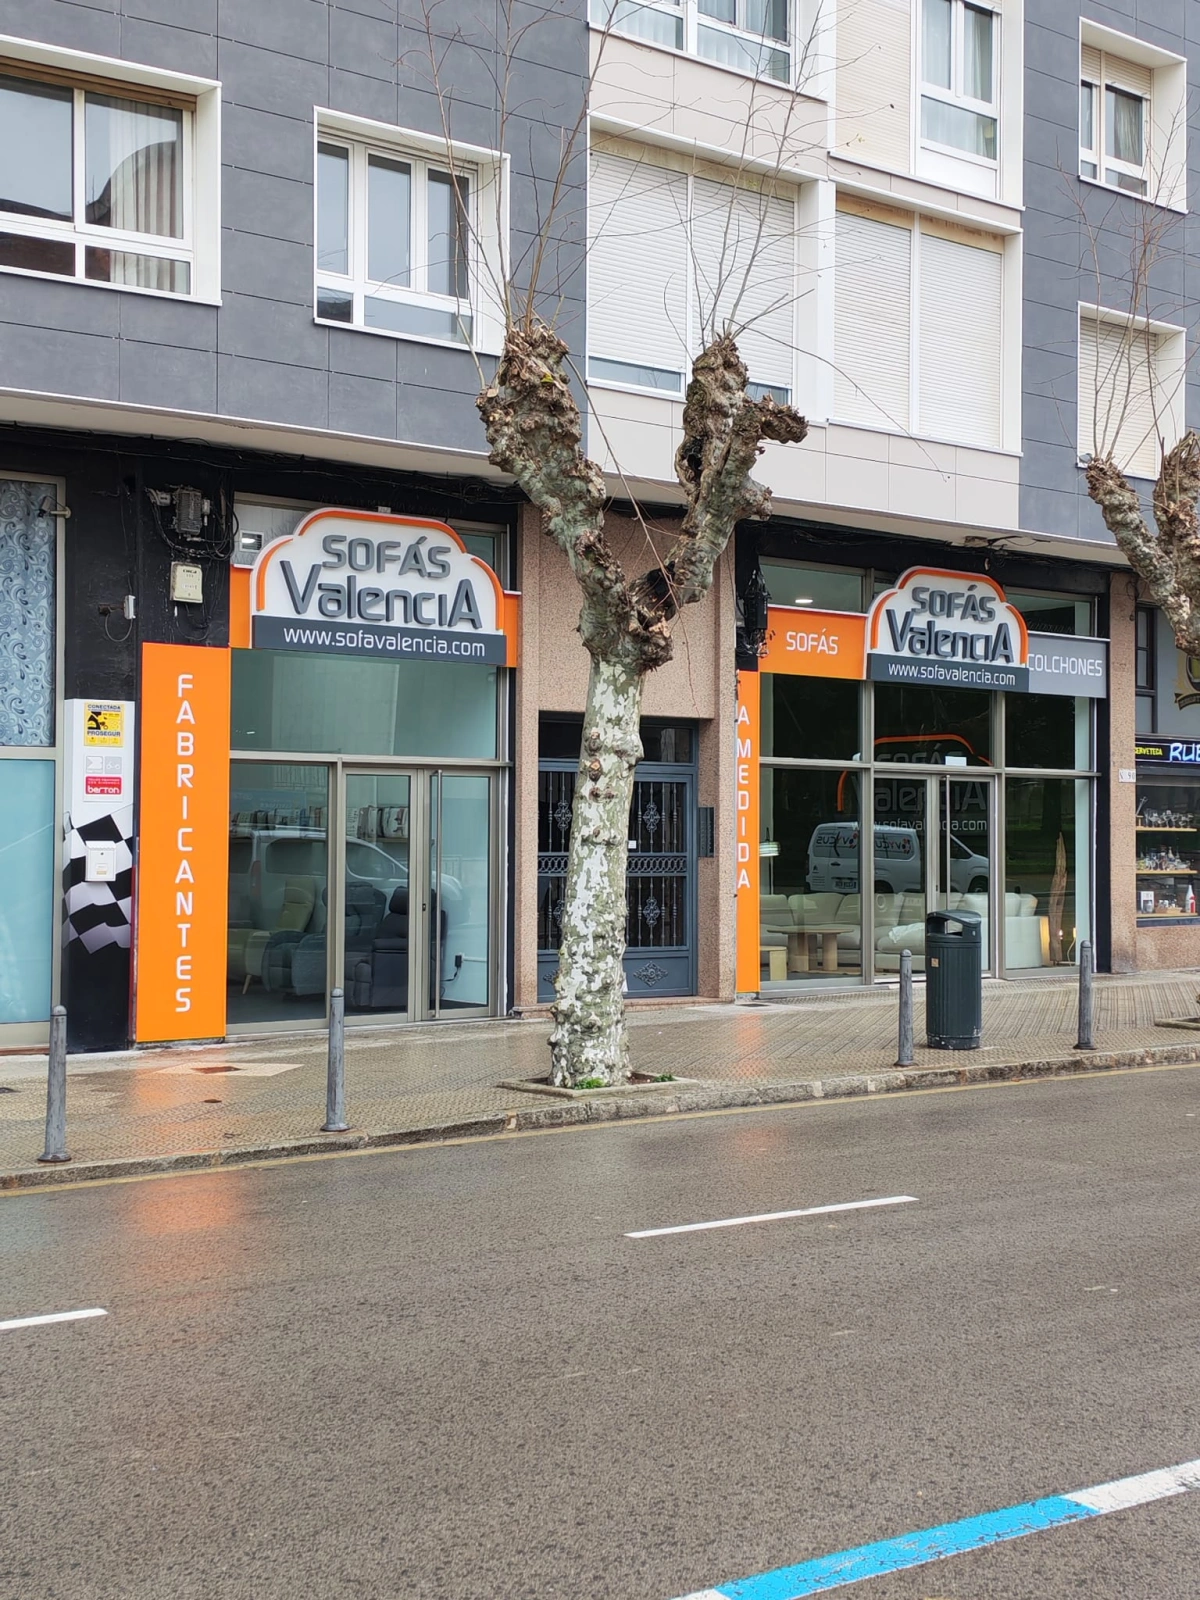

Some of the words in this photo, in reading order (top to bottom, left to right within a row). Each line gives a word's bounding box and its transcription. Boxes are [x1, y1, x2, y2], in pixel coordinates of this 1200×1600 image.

[322, 534, 452, 579] SOFÁS
[912, 584, 996, 623] SOFÁS
[283, 627, 486, 657] www.sofavalencia.com
[786, 628, 838, 655] SOFÁS
[888, 662, 1016, 686] www.sofavalencia.com
[1027, 654, 1103, 677] COLCHONES
[737, 705, 750, 725] A
[736, 738, 751, 889] MEDIDA
[175, 674, 196, 1013] FABRICANTES
